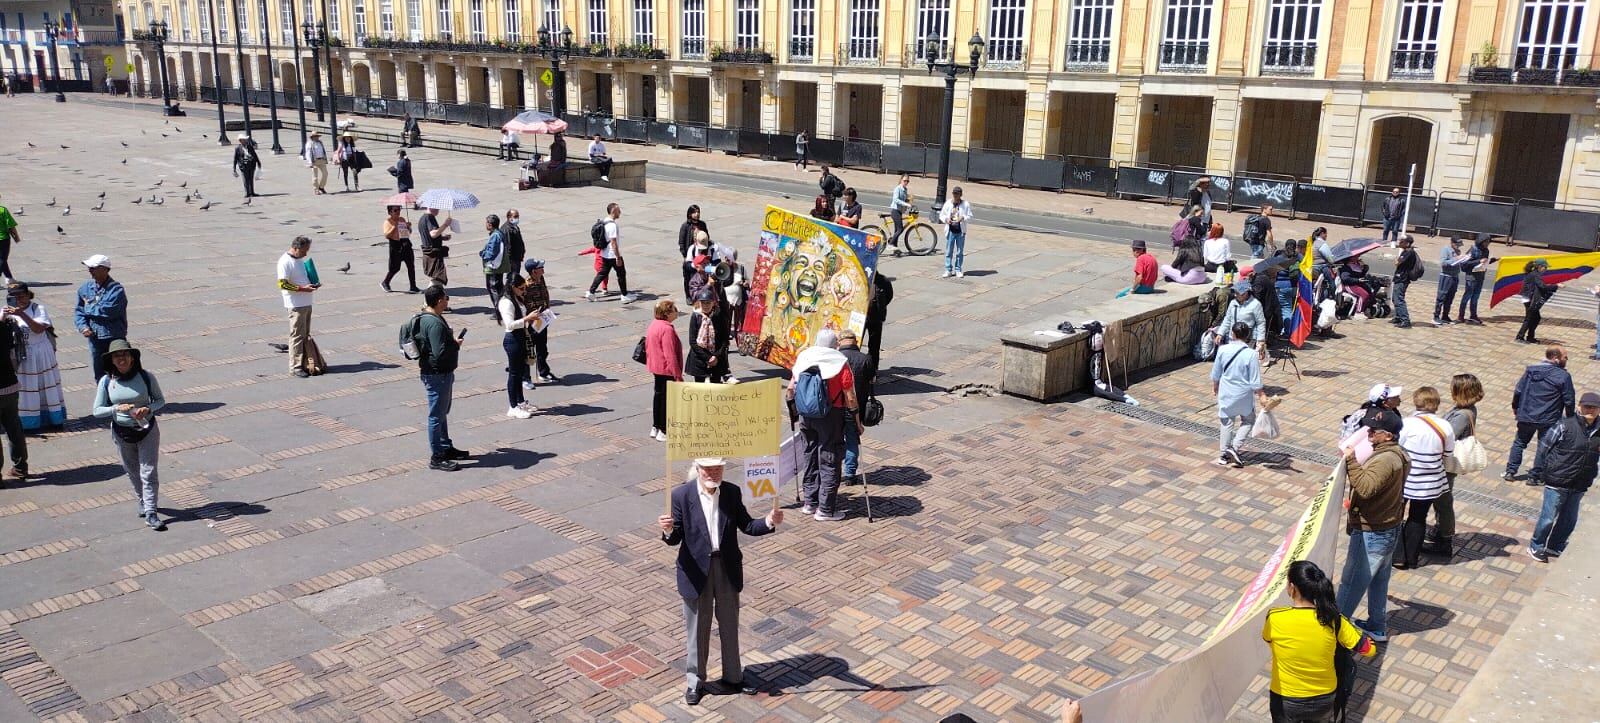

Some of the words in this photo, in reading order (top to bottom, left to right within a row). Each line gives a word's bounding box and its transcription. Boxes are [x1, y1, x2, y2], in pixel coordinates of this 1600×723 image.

[681, 386, 699, 402] En
[703, 389, 713, 402] el
[716, 391, 749, 402] nombre
[752, 387, 761, 399] de
[705, 404, 740, 417] DIOS
[747, 468, 776, 477] FISCAL
[747, 479, 776, 498] YA
